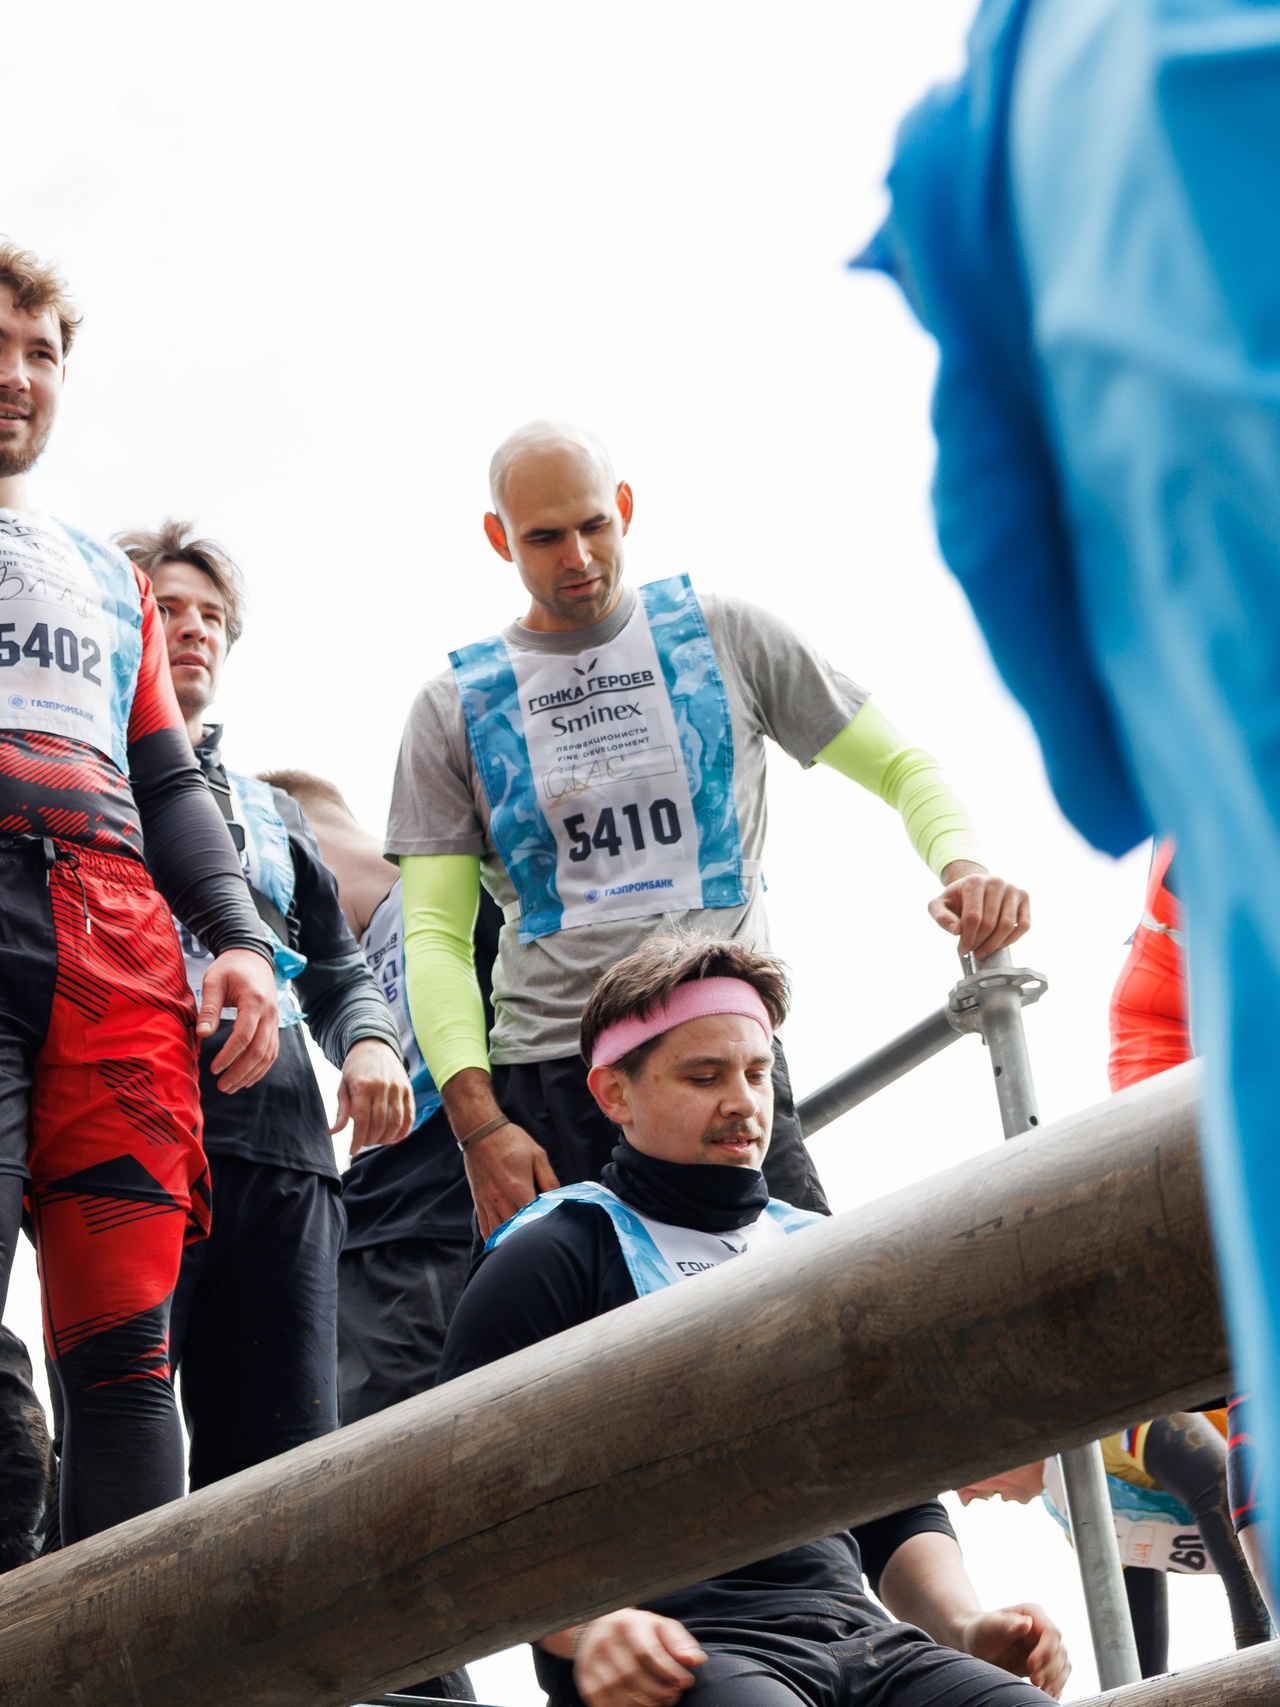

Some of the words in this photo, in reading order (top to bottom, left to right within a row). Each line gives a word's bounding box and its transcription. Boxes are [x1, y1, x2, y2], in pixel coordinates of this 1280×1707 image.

[528, 685, 585, 712] ГОНКА
[586, 670, 654, 692] ГЕРОЕВ
[30, 699, 95, 722] ГАЗПРОМБАНК
[550, 701, 643, 738] Sminex
[555, 726, 649, 754] ПЕРФЕКЦИОНИСТЫ
[557, 753, 579, 763] FINE
[582, 736, 650, 758] DEVELOPMENT
[562, 798, 682, 863] 5410
[604, 878, 674, 897] ГАЗПРОМБАНК
